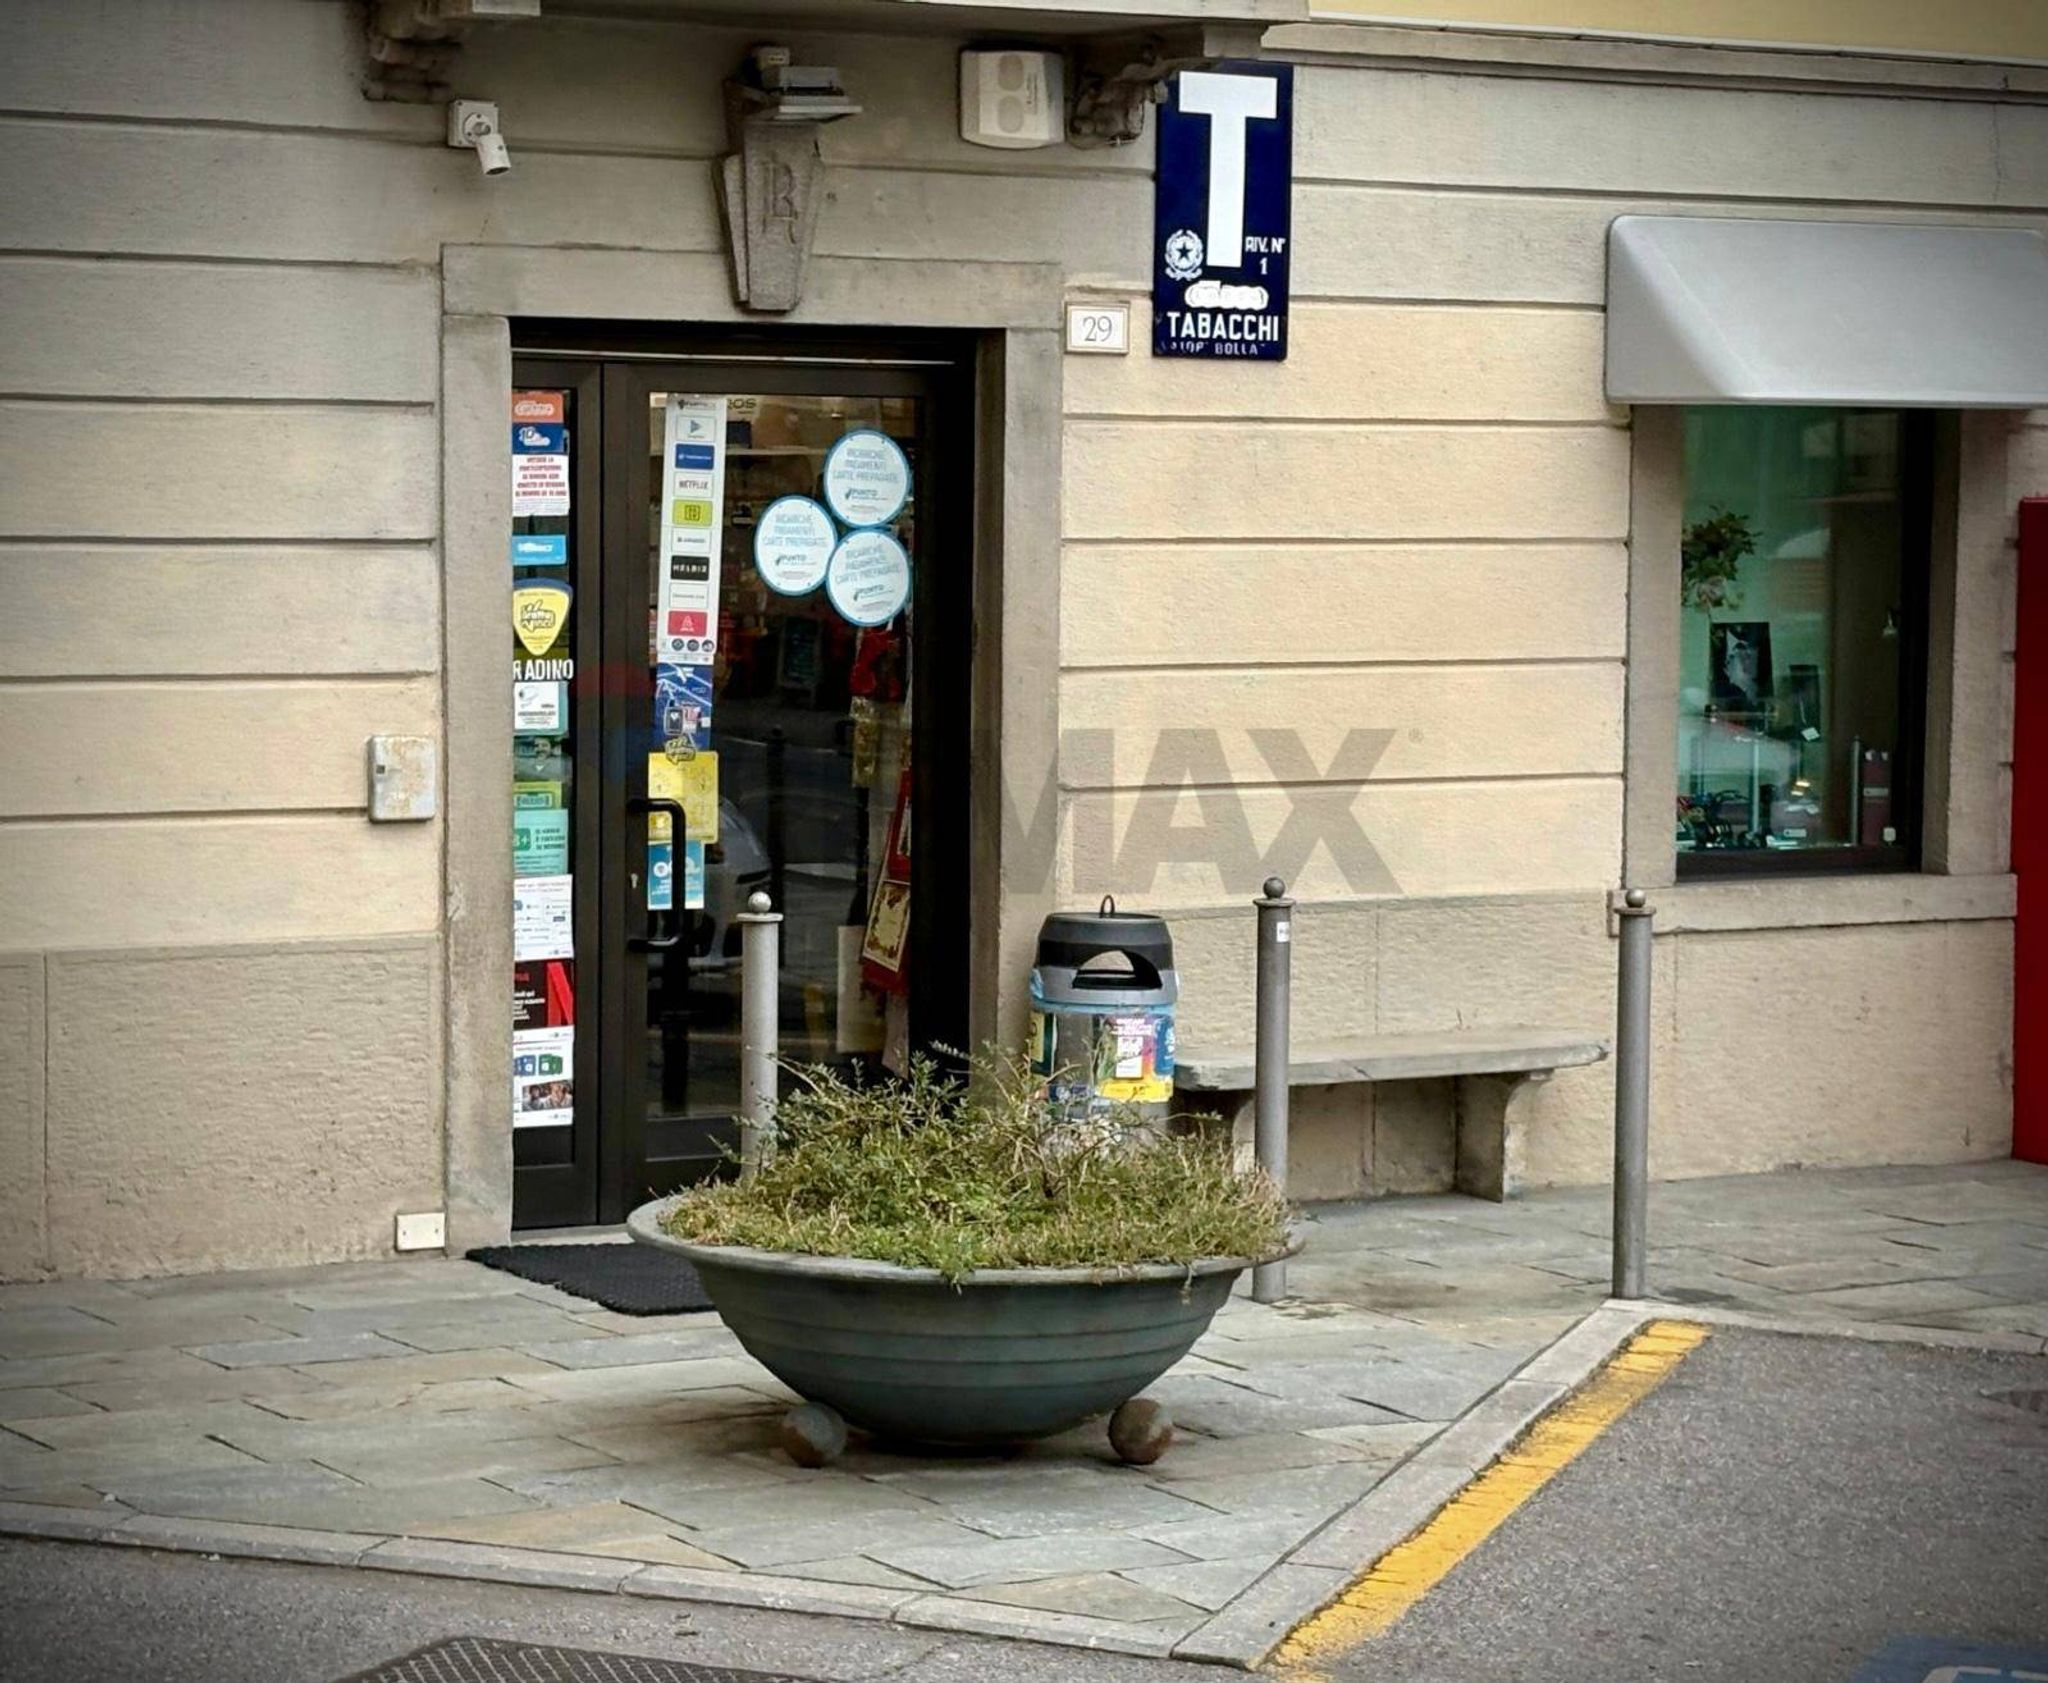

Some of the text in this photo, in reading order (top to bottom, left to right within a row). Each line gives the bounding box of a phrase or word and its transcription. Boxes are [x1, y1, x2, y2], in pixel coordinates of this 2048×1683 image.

[1179, 71, 1277, 267] T
[1260, 257, 1268, 275] 1
[1083, 315, 1113, 342] 29
[1167, 311, 1279, 341] TABACCHI
